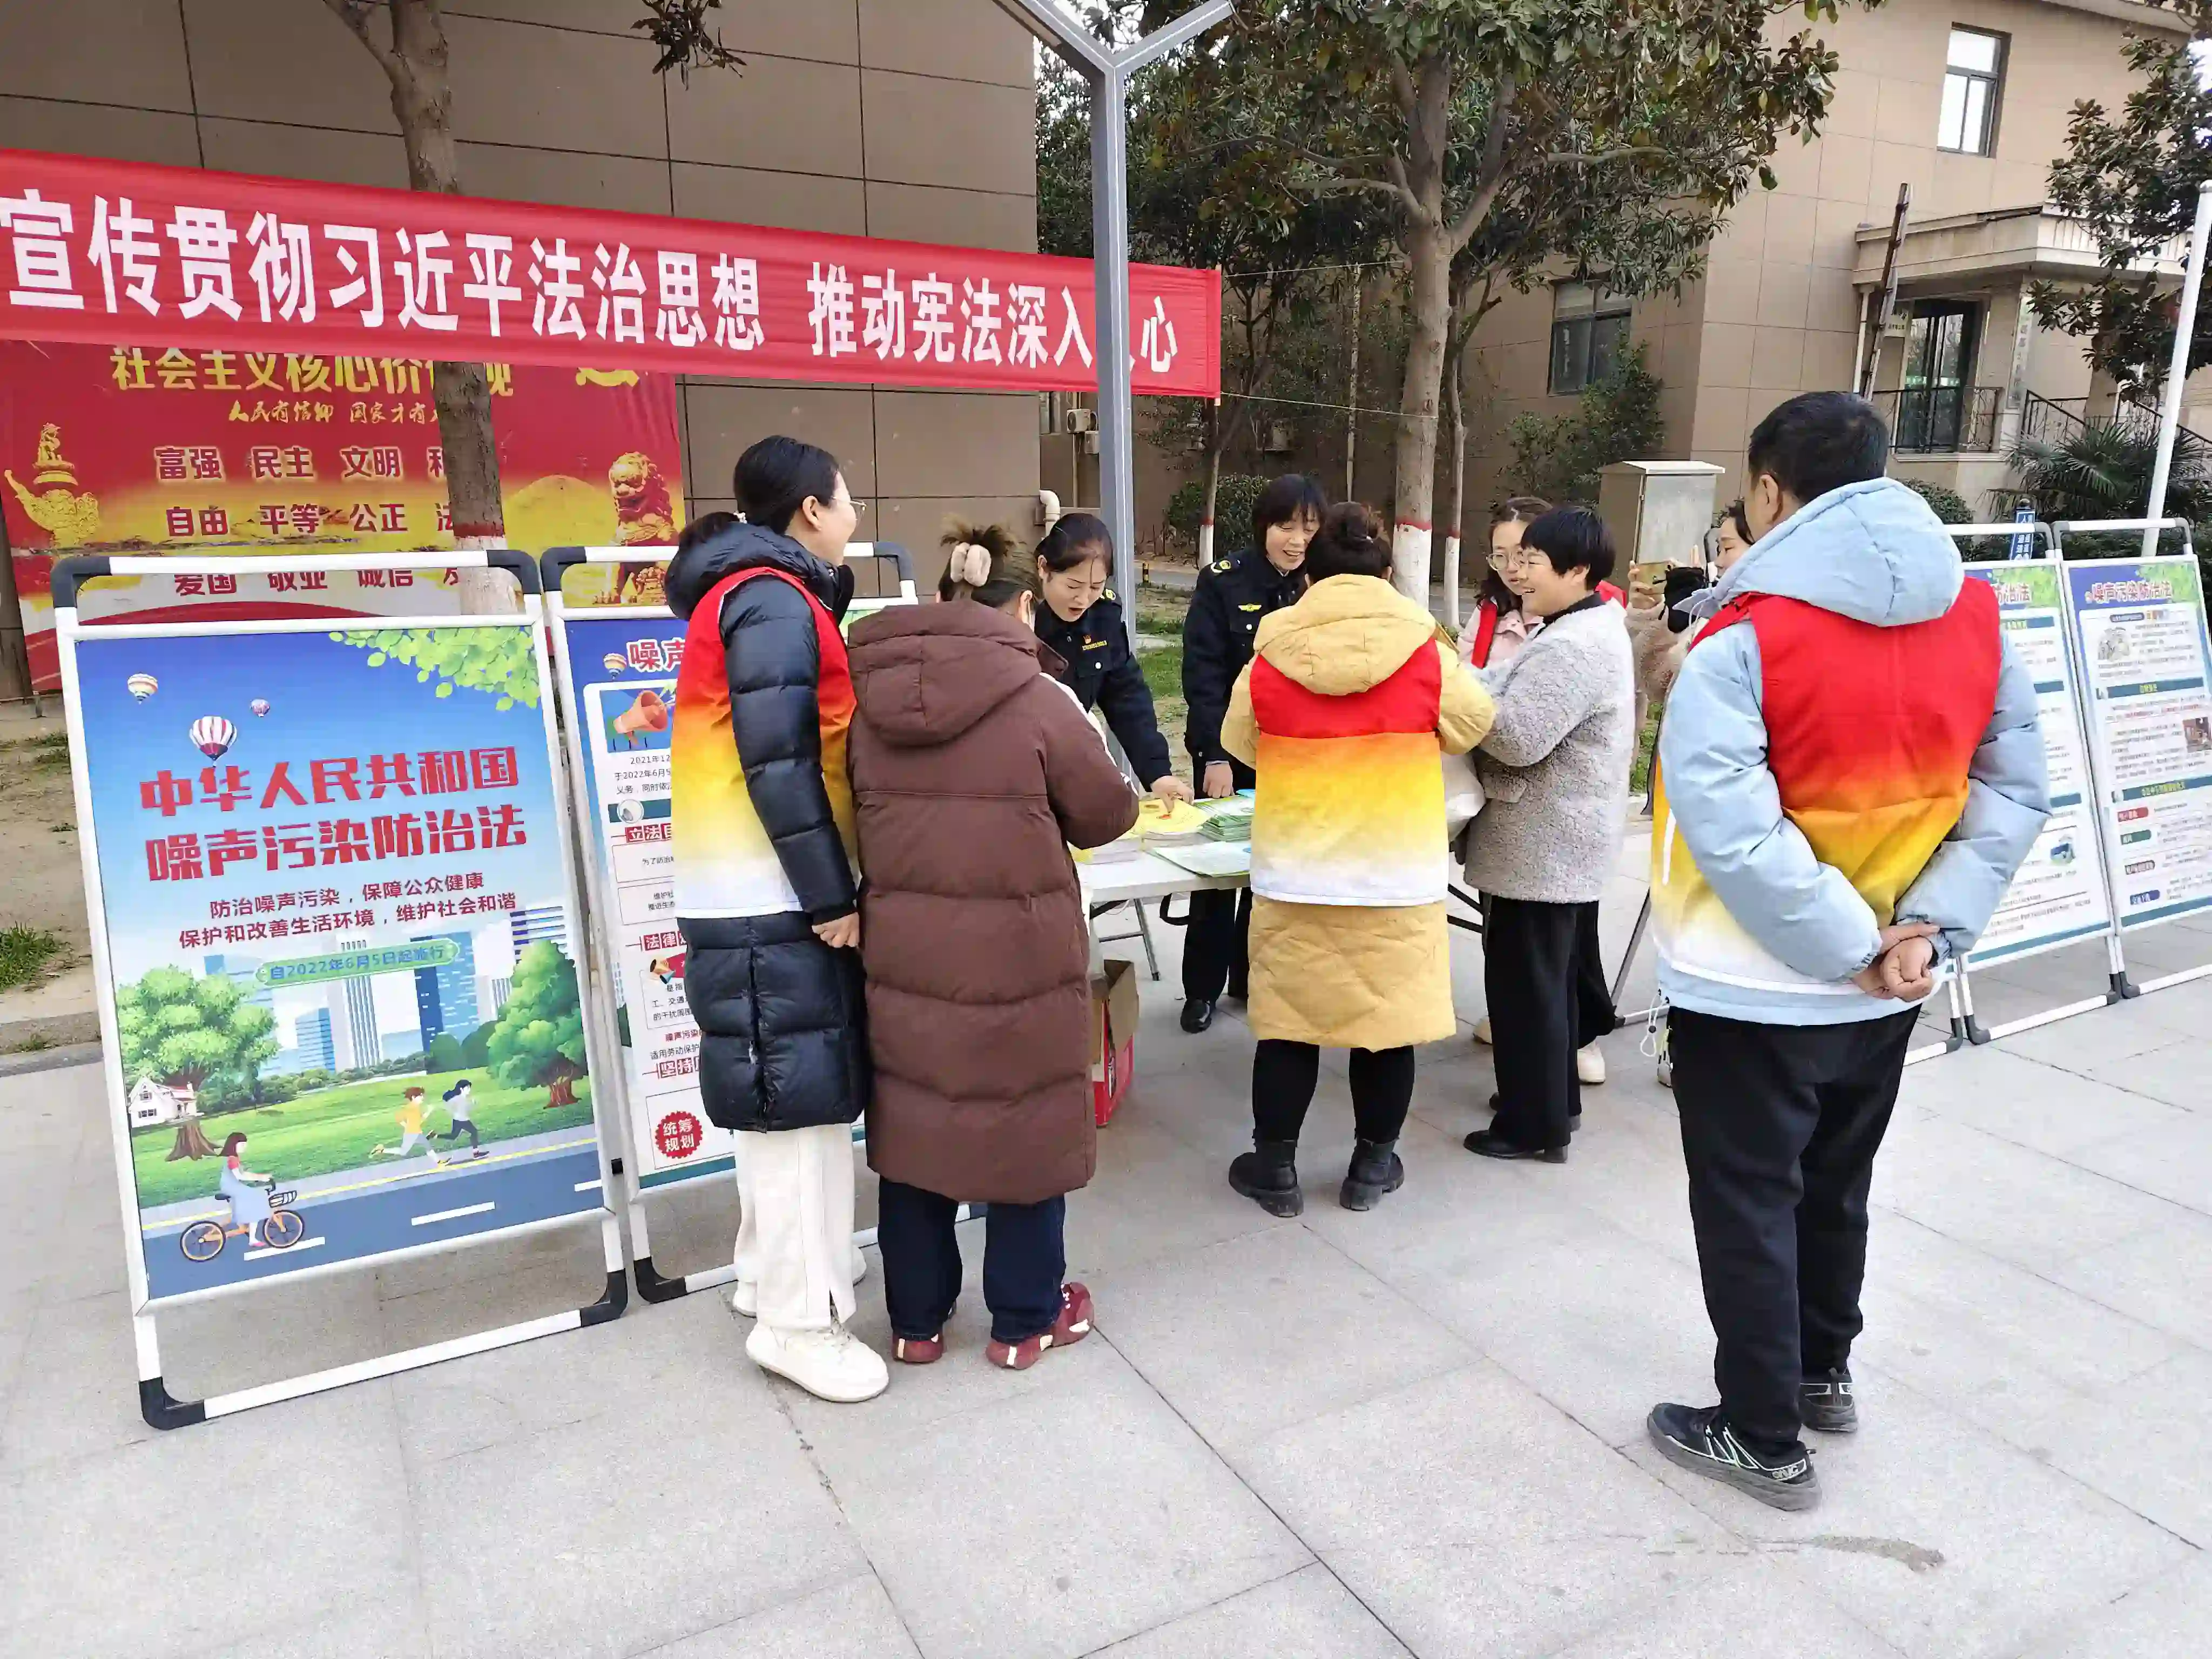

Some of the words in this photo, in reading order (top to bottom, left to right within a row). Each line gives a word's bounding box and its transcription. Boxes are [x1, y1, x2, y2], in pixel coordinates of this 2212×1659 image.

[0, 188, 765, 351] 宣传贯彻习近平法治思想
[806, 261, 1178, 373] 推动宪法深入心
[110, 347, 514, 397] 社会主义核心价
[349, 401, 439, 424] 国家才有
[154, 446, 222, 480] 富强
[252, 447, 314, 478] 民主
[340, 447, 401, 478] 文明
[165, 505, 228, 537] 自由
[259, 503, 319, 535] 平等
[349, 503, 408, 532] 公正
[173, 574, 237, 597] 爱国
[267, 571, 328, 592] 敬业
[356, 568, 414, 588] 诚信
[139, 745, 520, 817] 中华人民共和国
[144, 804, 528, 882] 噪声污染防治法
[269, 945, 446, 980] 自2022年6月5日起施行
[665, 1028, 702, 1042] 噪声污染
[660, 1057, 699, 1078] 坚持
